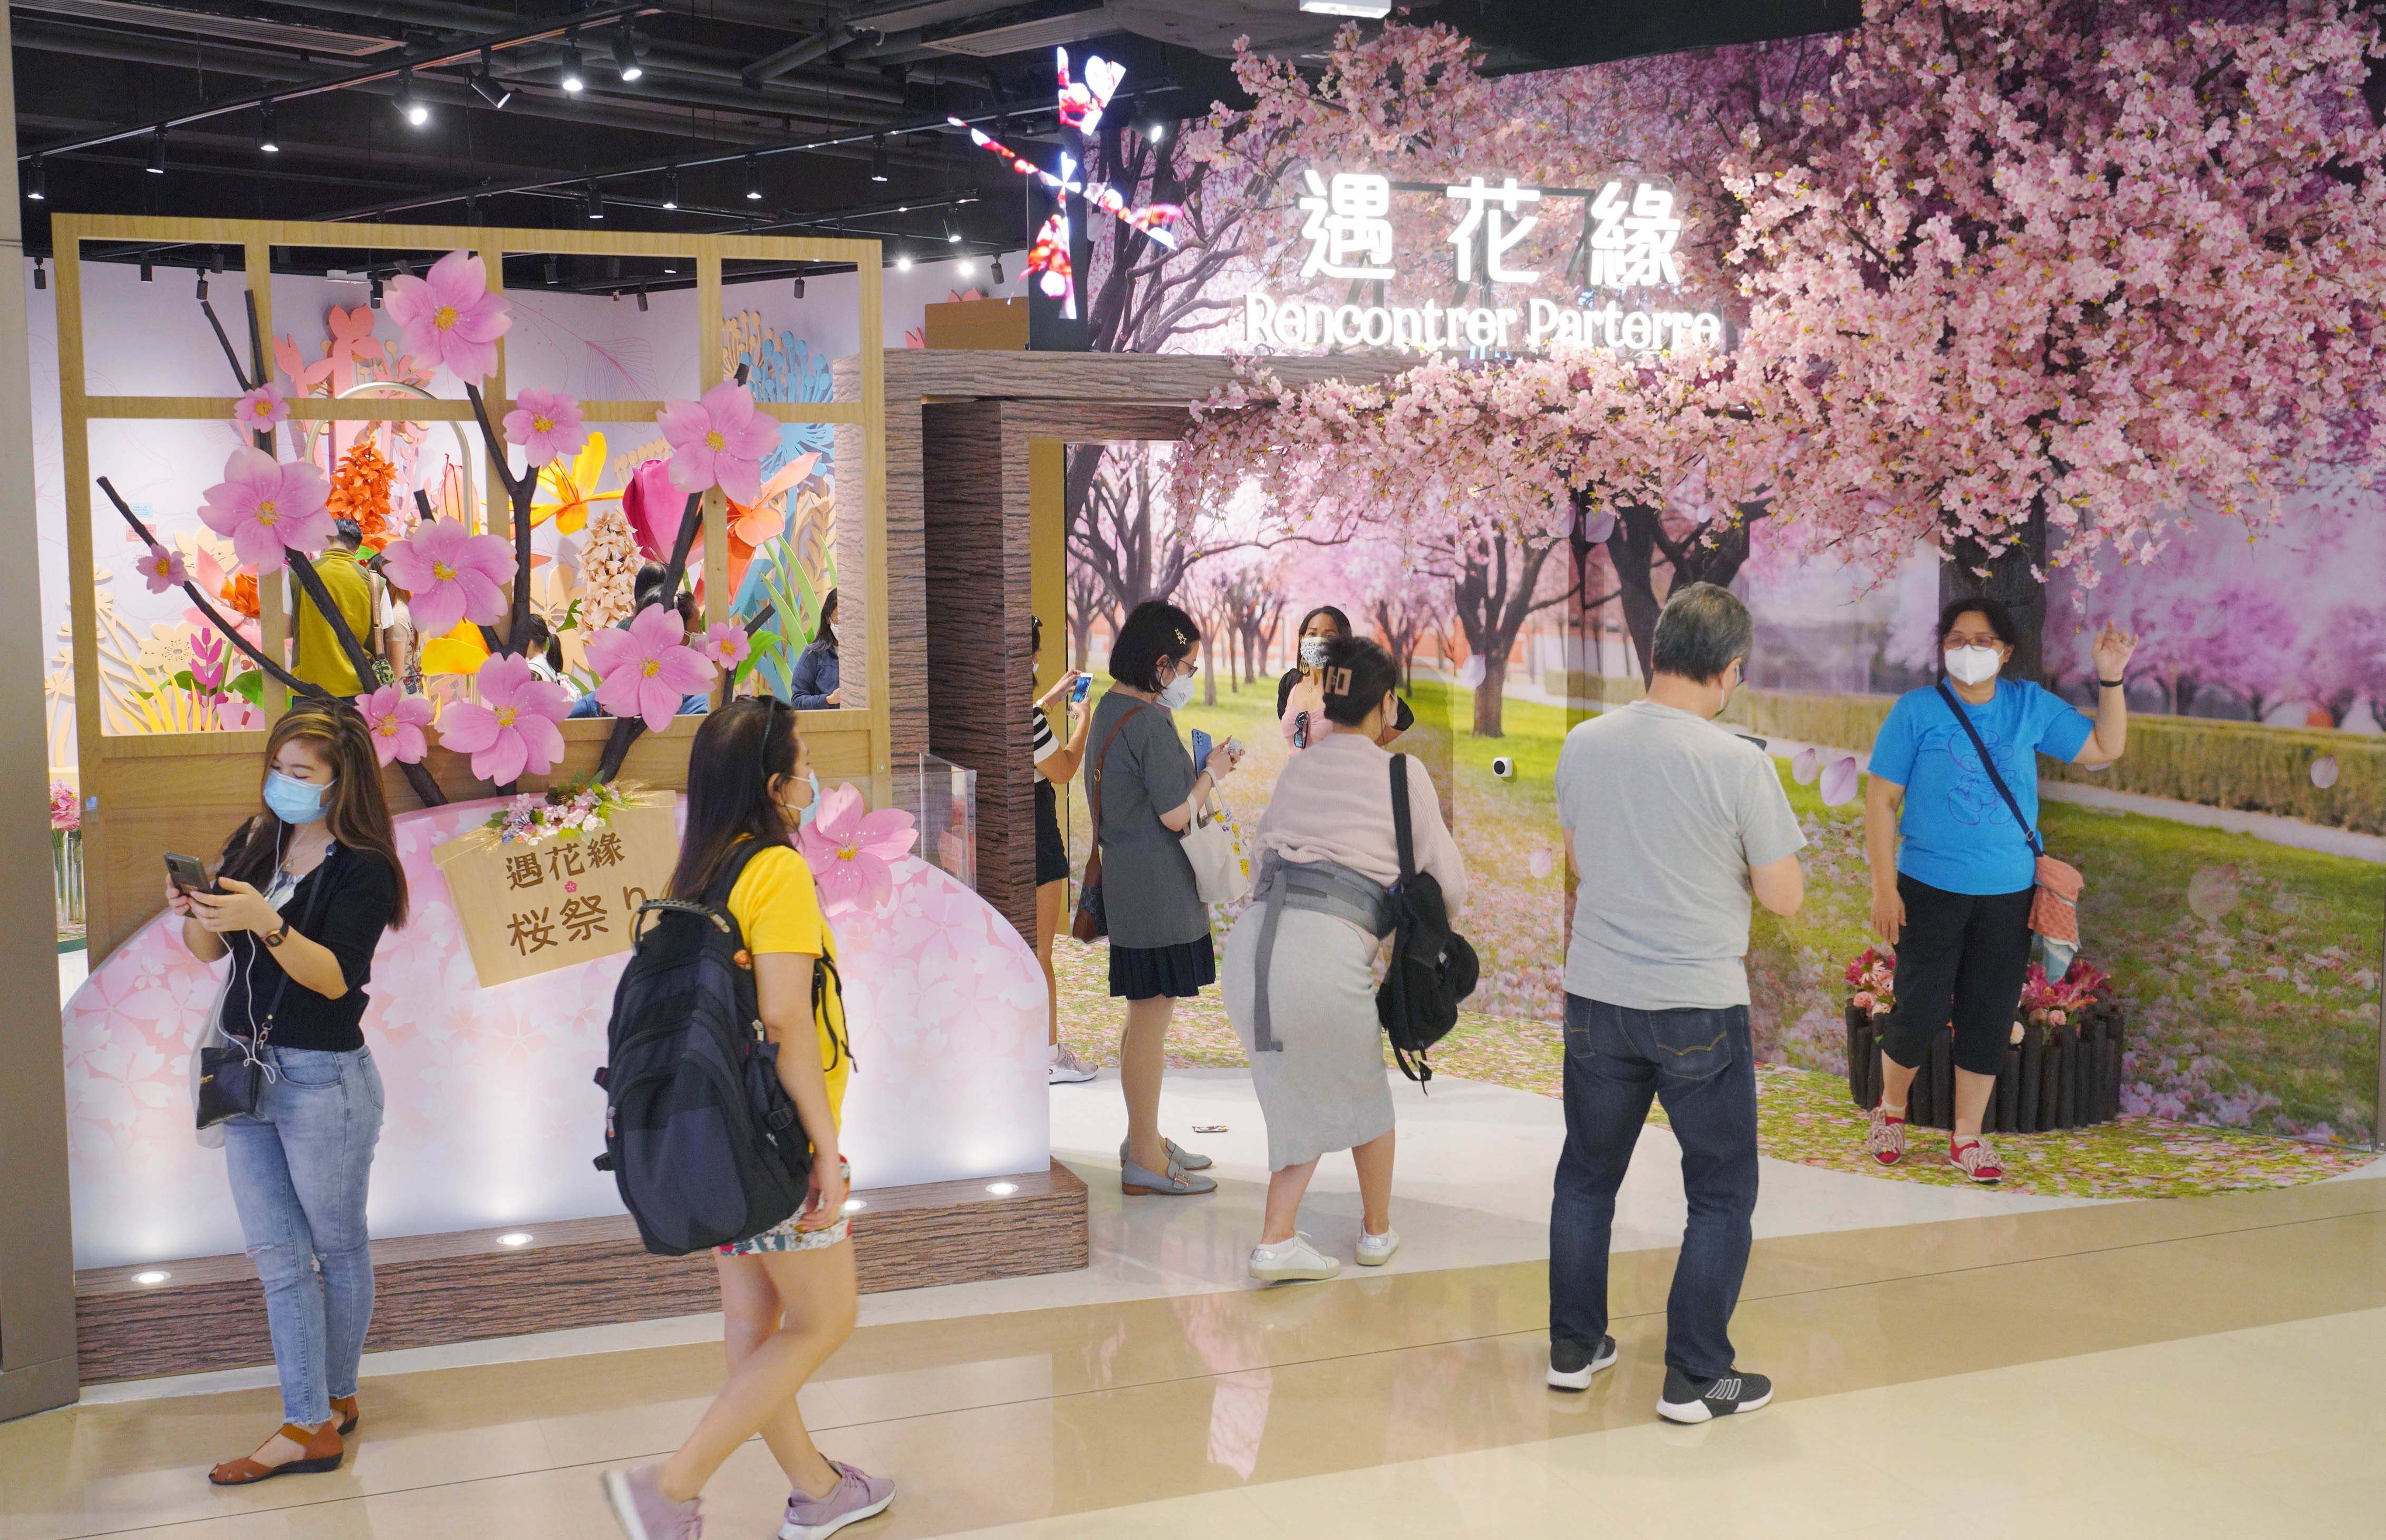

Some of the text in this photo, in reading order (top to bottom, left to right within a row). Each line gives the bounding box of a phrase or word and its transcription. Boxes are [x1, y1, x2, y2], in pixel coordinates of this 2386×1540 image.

[1299, 169, 1680, 286] 遇花緣
[1245, 292, 1721, 350] Rencontrer Parterre
[506, 832, 625, 891] 遇花緣
